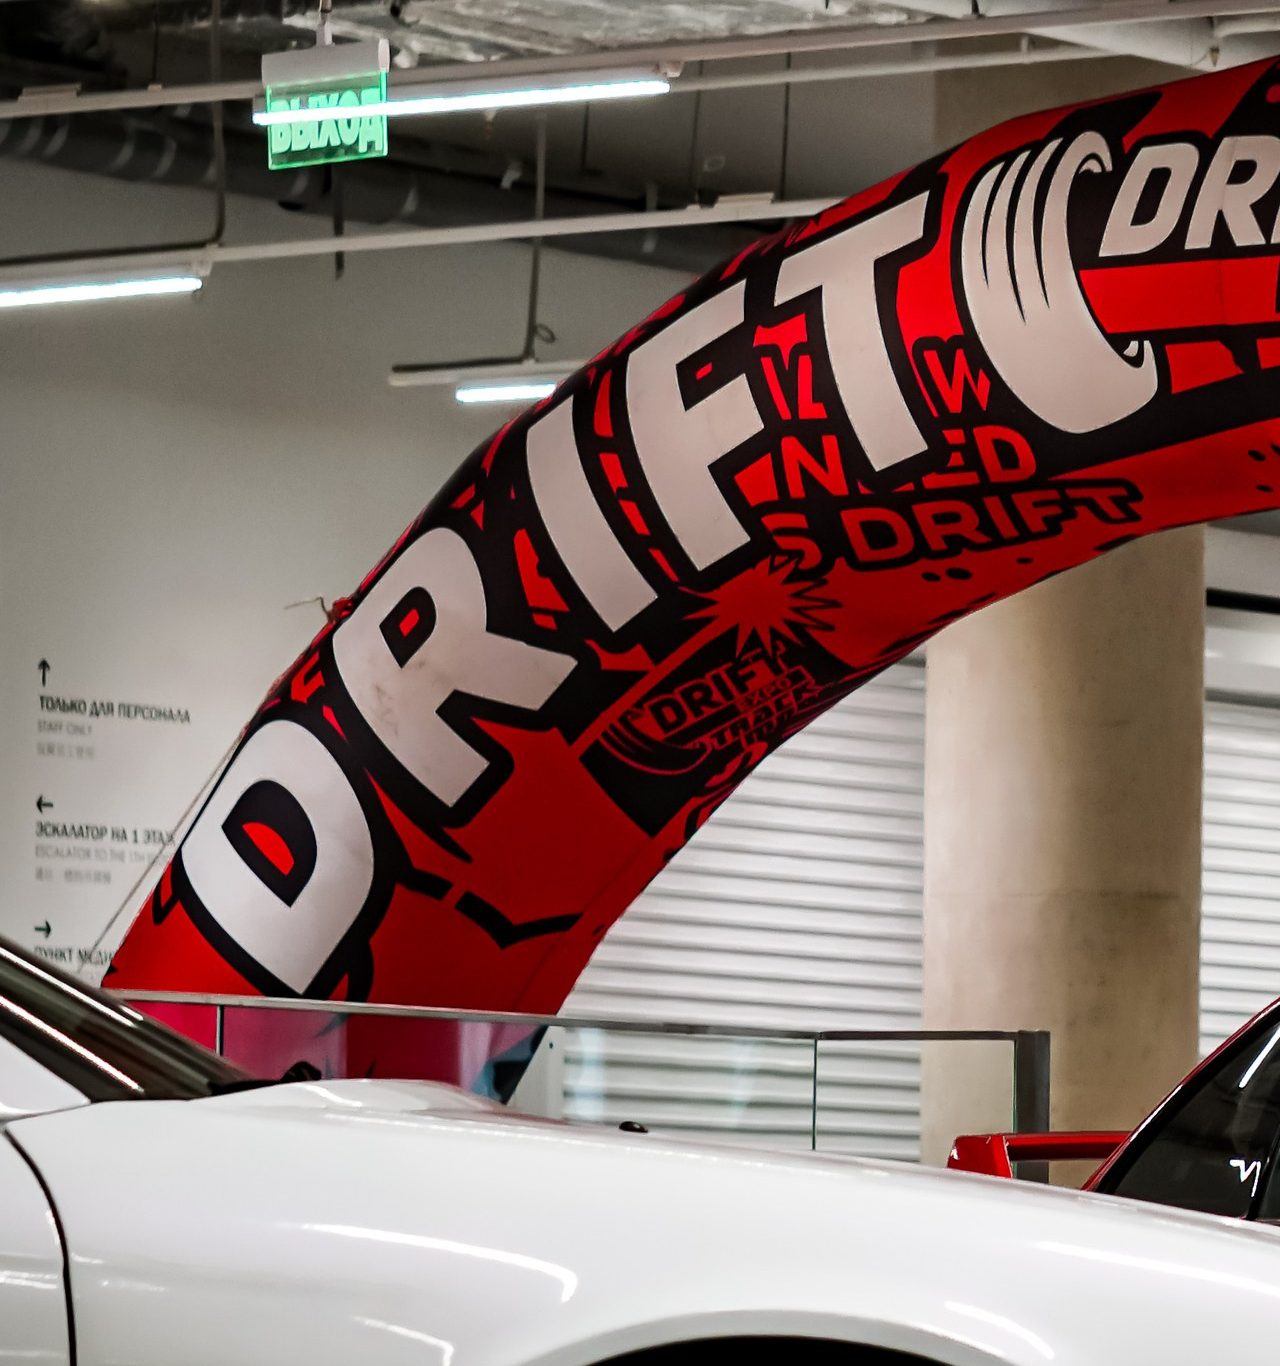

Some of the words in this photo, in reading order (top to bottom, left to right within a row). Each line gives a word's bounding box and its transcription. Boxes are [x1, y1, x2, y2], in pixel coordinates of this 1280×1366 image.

[271, 87, 383, 154] ВЫХОД
[840, 486, 1142, 563] DRIFT
[181, 191, 930, 997] DRIFT
[40, 695, 87, 715] ТОЛЬКО
[89, 701, 115, 718] ДЛЯ
[118, 703, 190, 723] ПЕРСОНАЛА
[648, 640, 788, 732] DRIFT
[36, 821, 107, 840] ЭСКАЛАТОР
[112, 827, 128, 843] НА
